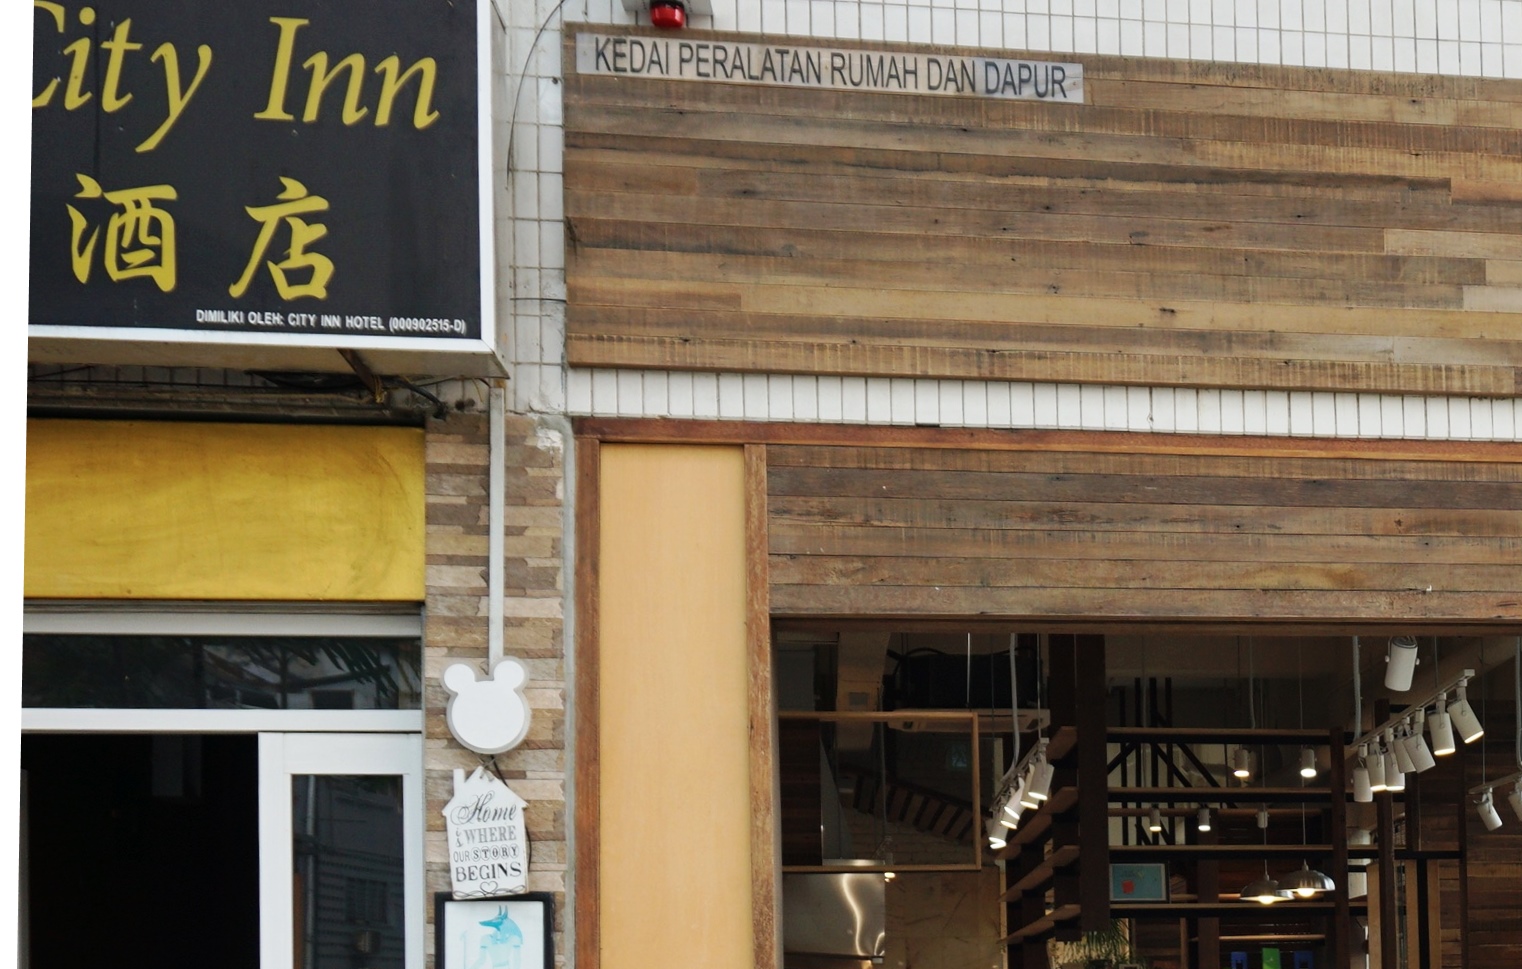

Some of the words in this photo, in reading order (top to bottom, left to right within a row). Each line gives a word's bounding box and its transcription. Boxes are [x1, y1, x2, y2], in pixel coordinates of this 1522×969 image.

[254, 16, 441, 130] Inn
[594, 36, 670, 75] KEDAI
[678, 42, 823, 86] PERALATAN
[831, 52, 918, 91] RUMAH
[927, 57, 977, 93] DAN
[985, 60, 1068, 99] DAPUR
[66, 173, 335, 301] 酒店
[196, 308, 245, 325] DIMILIKI
[248, 310, 285, 326] OLEH:
[288, 312, 317, 328] CITY
[321, 314, 342, 328] INN
[346, 315, 385, 330] HOTEL
[450, 790, 517, 826] Home
[463, 825, 517, 846] WHERE
[453, 850, 470, 863] OUR
[471, 843, 520, 861] STORY
[455, 861, 523, 883] BEGINS
